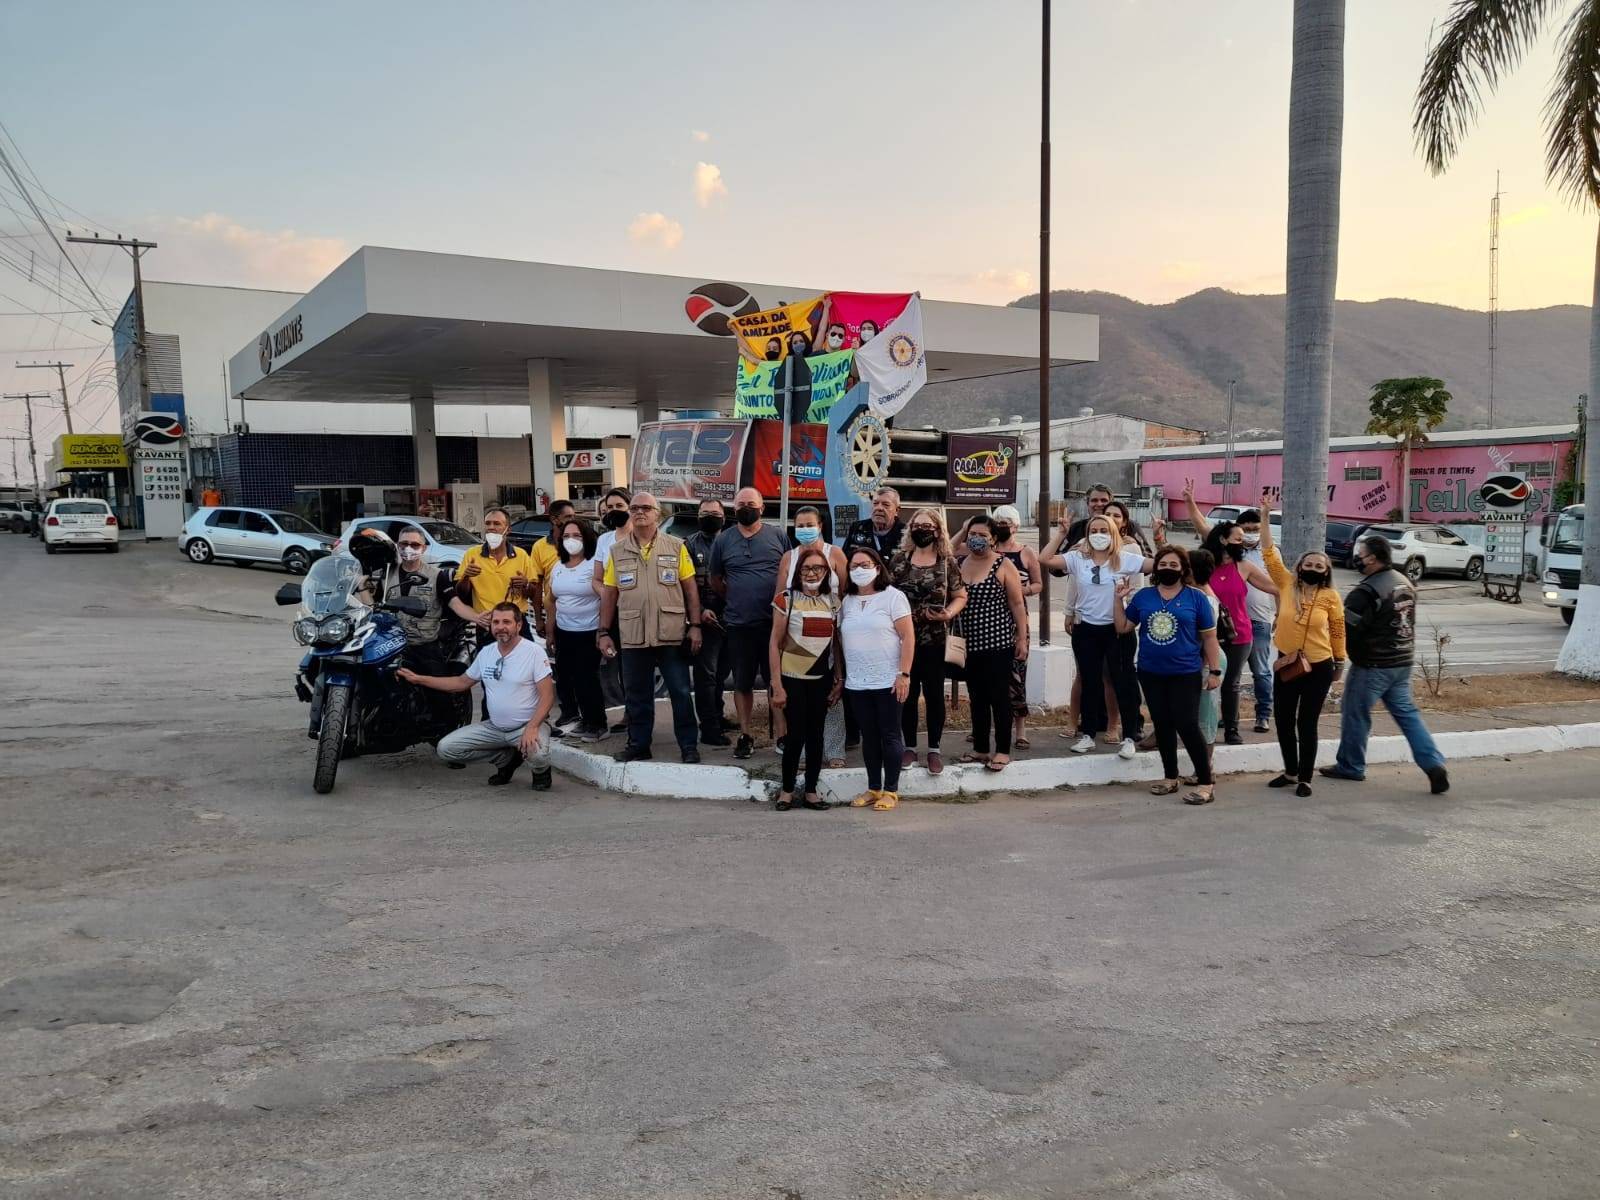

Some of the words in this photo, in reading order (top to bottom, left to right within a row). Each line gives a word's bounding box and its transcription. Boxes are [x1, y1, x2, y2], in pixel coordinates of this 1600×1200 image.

[738, 317, 768, 326] CASA
[771, 311, 787, 321] DA
[743, 322, 792, 336] AMIZADE
[273, 313, 304, 358] XAVANTE
[136, 451, 185, 459] XAVANTE
[559, 455, 568, 465] D
[580, 454, 588, 464] G
[954, 458, 977, 474] CASA
[1450, 466, 1476, 475] TINTAS
[1480, 513, 1527, 521] XAVANTE
